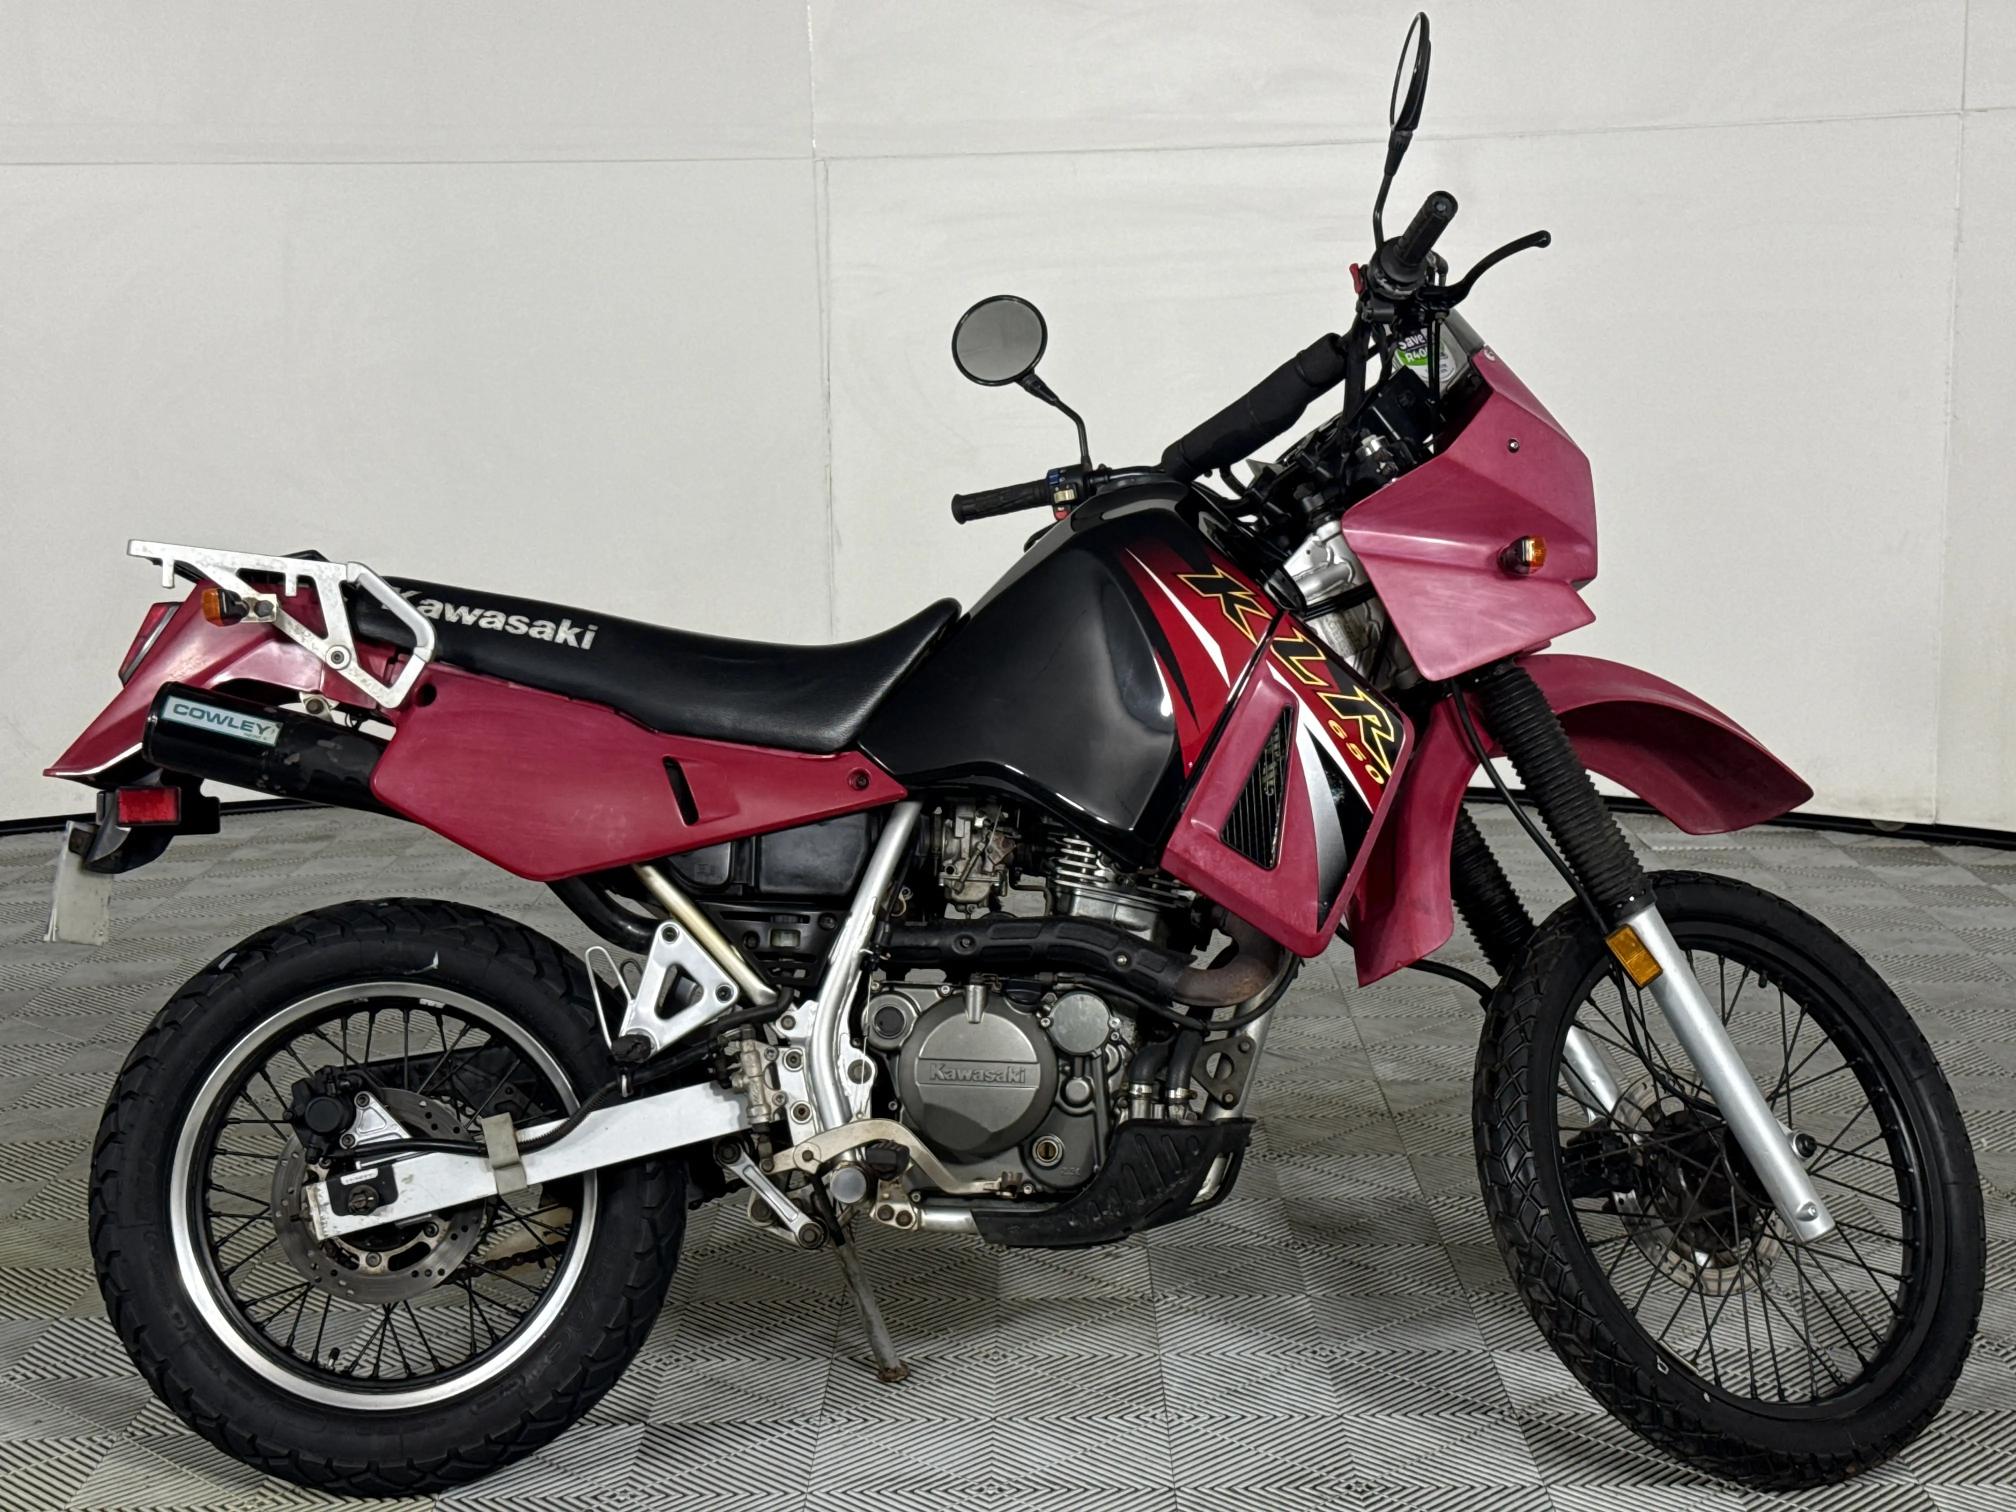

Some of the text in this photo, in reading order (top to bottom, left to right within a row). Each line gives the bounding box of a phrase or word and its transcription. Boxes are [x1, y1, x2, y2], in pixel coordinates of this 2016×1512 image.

[381, 586, 599, 650] awasaki
[173, 703, 271, 735] COWLEY
[1328, 719, 1385, 785] 650
[929, 1062, 1026, 1084] Kawasaki
